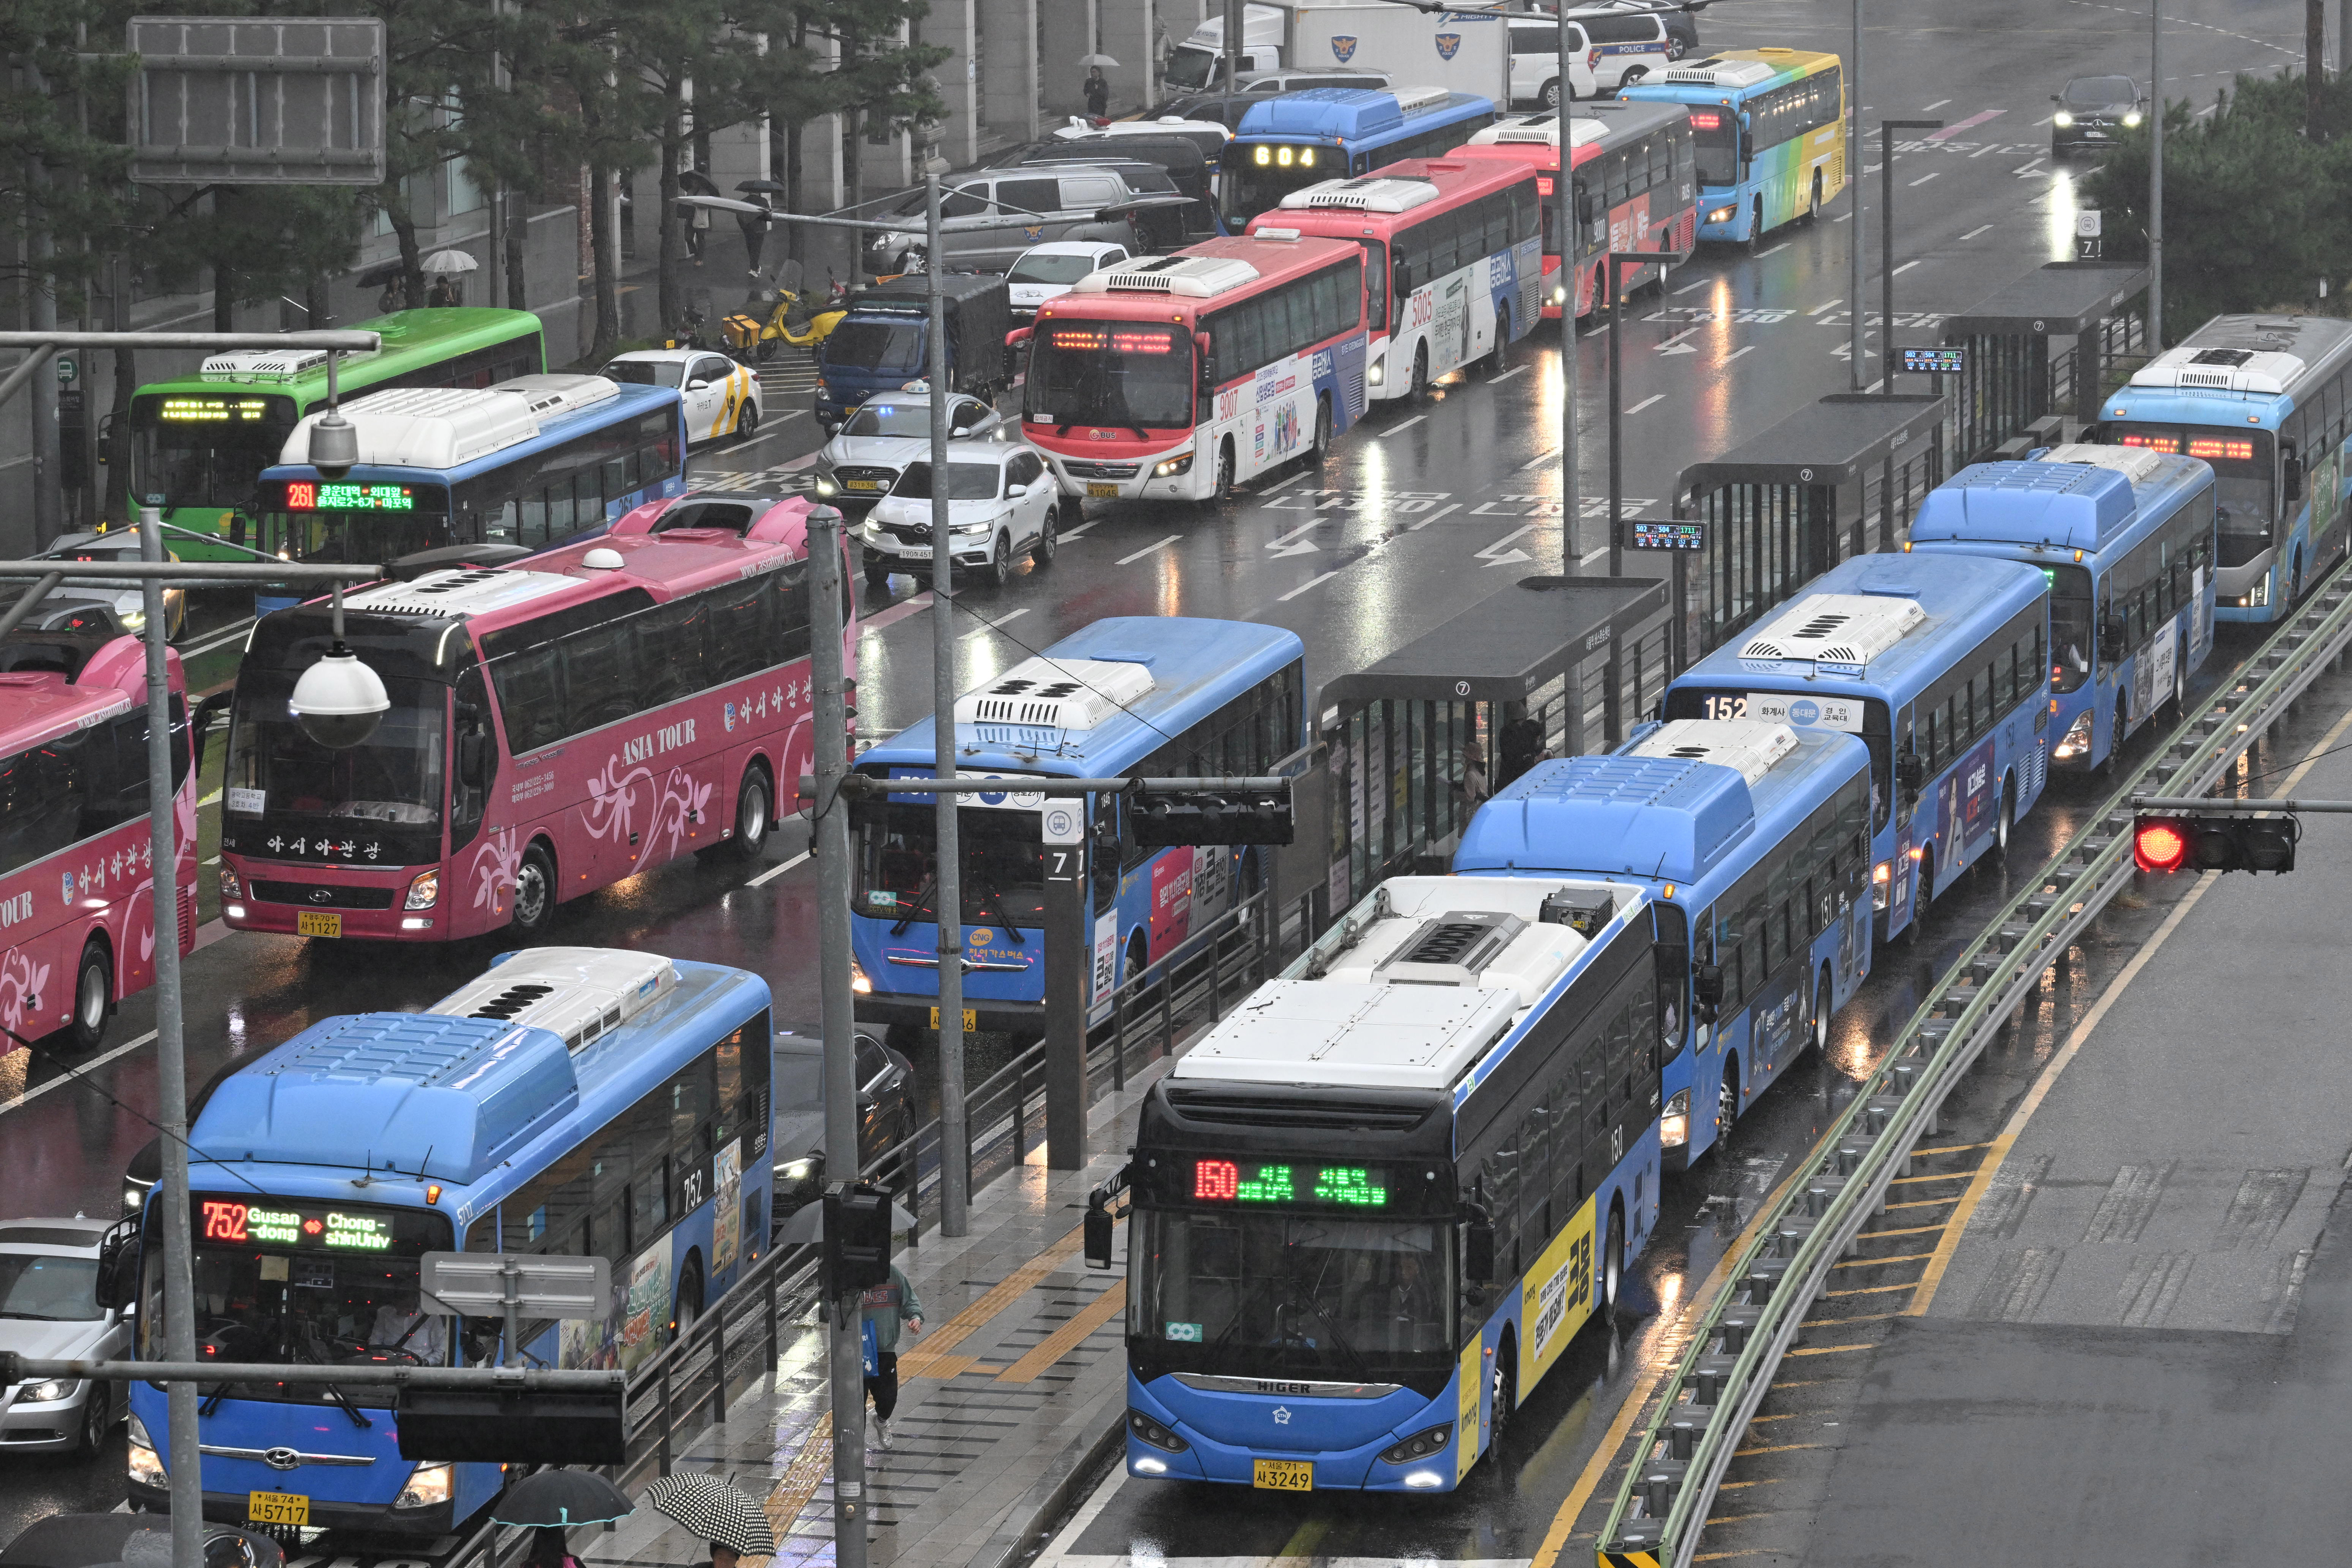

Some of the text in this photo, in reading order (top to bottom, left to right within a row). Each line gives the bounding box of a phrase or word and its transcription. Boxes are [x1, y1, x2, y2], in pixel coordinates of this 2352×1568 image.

[1619, 45, 1645, 54] POLICE
[1256, 147, 1313, 166] 604
[1682, 183, 1690, 201] BUS
[1594, 219, 1605, 243] 9000
[2084, 241, 2092, 254] 7
[1491, 252, 1511, 288] 공공버스
[1412, 290, 1432, 327] 5005
[1312, 349, 1331, 380] 공공버스
[696, 399, 711, 412] 카카오T
[1220, 389, 1238, 422] 9007
[289, 484, 314, 507] 261
[318, 496, 412, 509] 을지로2-6가 마포역
[320, 485, 400, 498] 광운대역 외대앞
[1705, 696, 1747, 720] 152
[1761, 707, 1785, 717] 화계사
[1792, 708, 1816, 718] 동대문
[622, 718, 696, 767] ASIA TOUR
[2006, 721, 2014, 750] 152
[512, 783, 523, 793] 국내부
[248, 801, 259, 809] 4반
[223, 837, 235, 848] 전세
[267, 835, 381, 860] 아시아관광
[1054, 852, 1067, 874] 7
[1821, 892, 1832, 928] 151
[971, 932, 990, 942] CNG
[754, 1131, 766, 1150] 선진운수
[1612, 1124, 1622, 1165] 150
[684, 1168, 702, 1213] 752
[1195, 1161, 1237, 1198] 150
[203, 1202, 248, 1240] 752
[247, 1207, 300, 1226] Gusan
[327, 1212, 375, 1232] Chong
[456, 1201, 473, 1226] 5717
[248, 1225, 298, 1242] -dong
[1568, 1230, 1591, 1313] 크몽
[1524, 1282, 1536, 1306] kmong
[1535, 1288, 1565, 1352] 전문가 필요해?
[1258, 1381, 1311, 1394] HIGER
[1461, 1401, 1477, 1435] kmong
[264, 1494, 294, 1504] 서울 74
